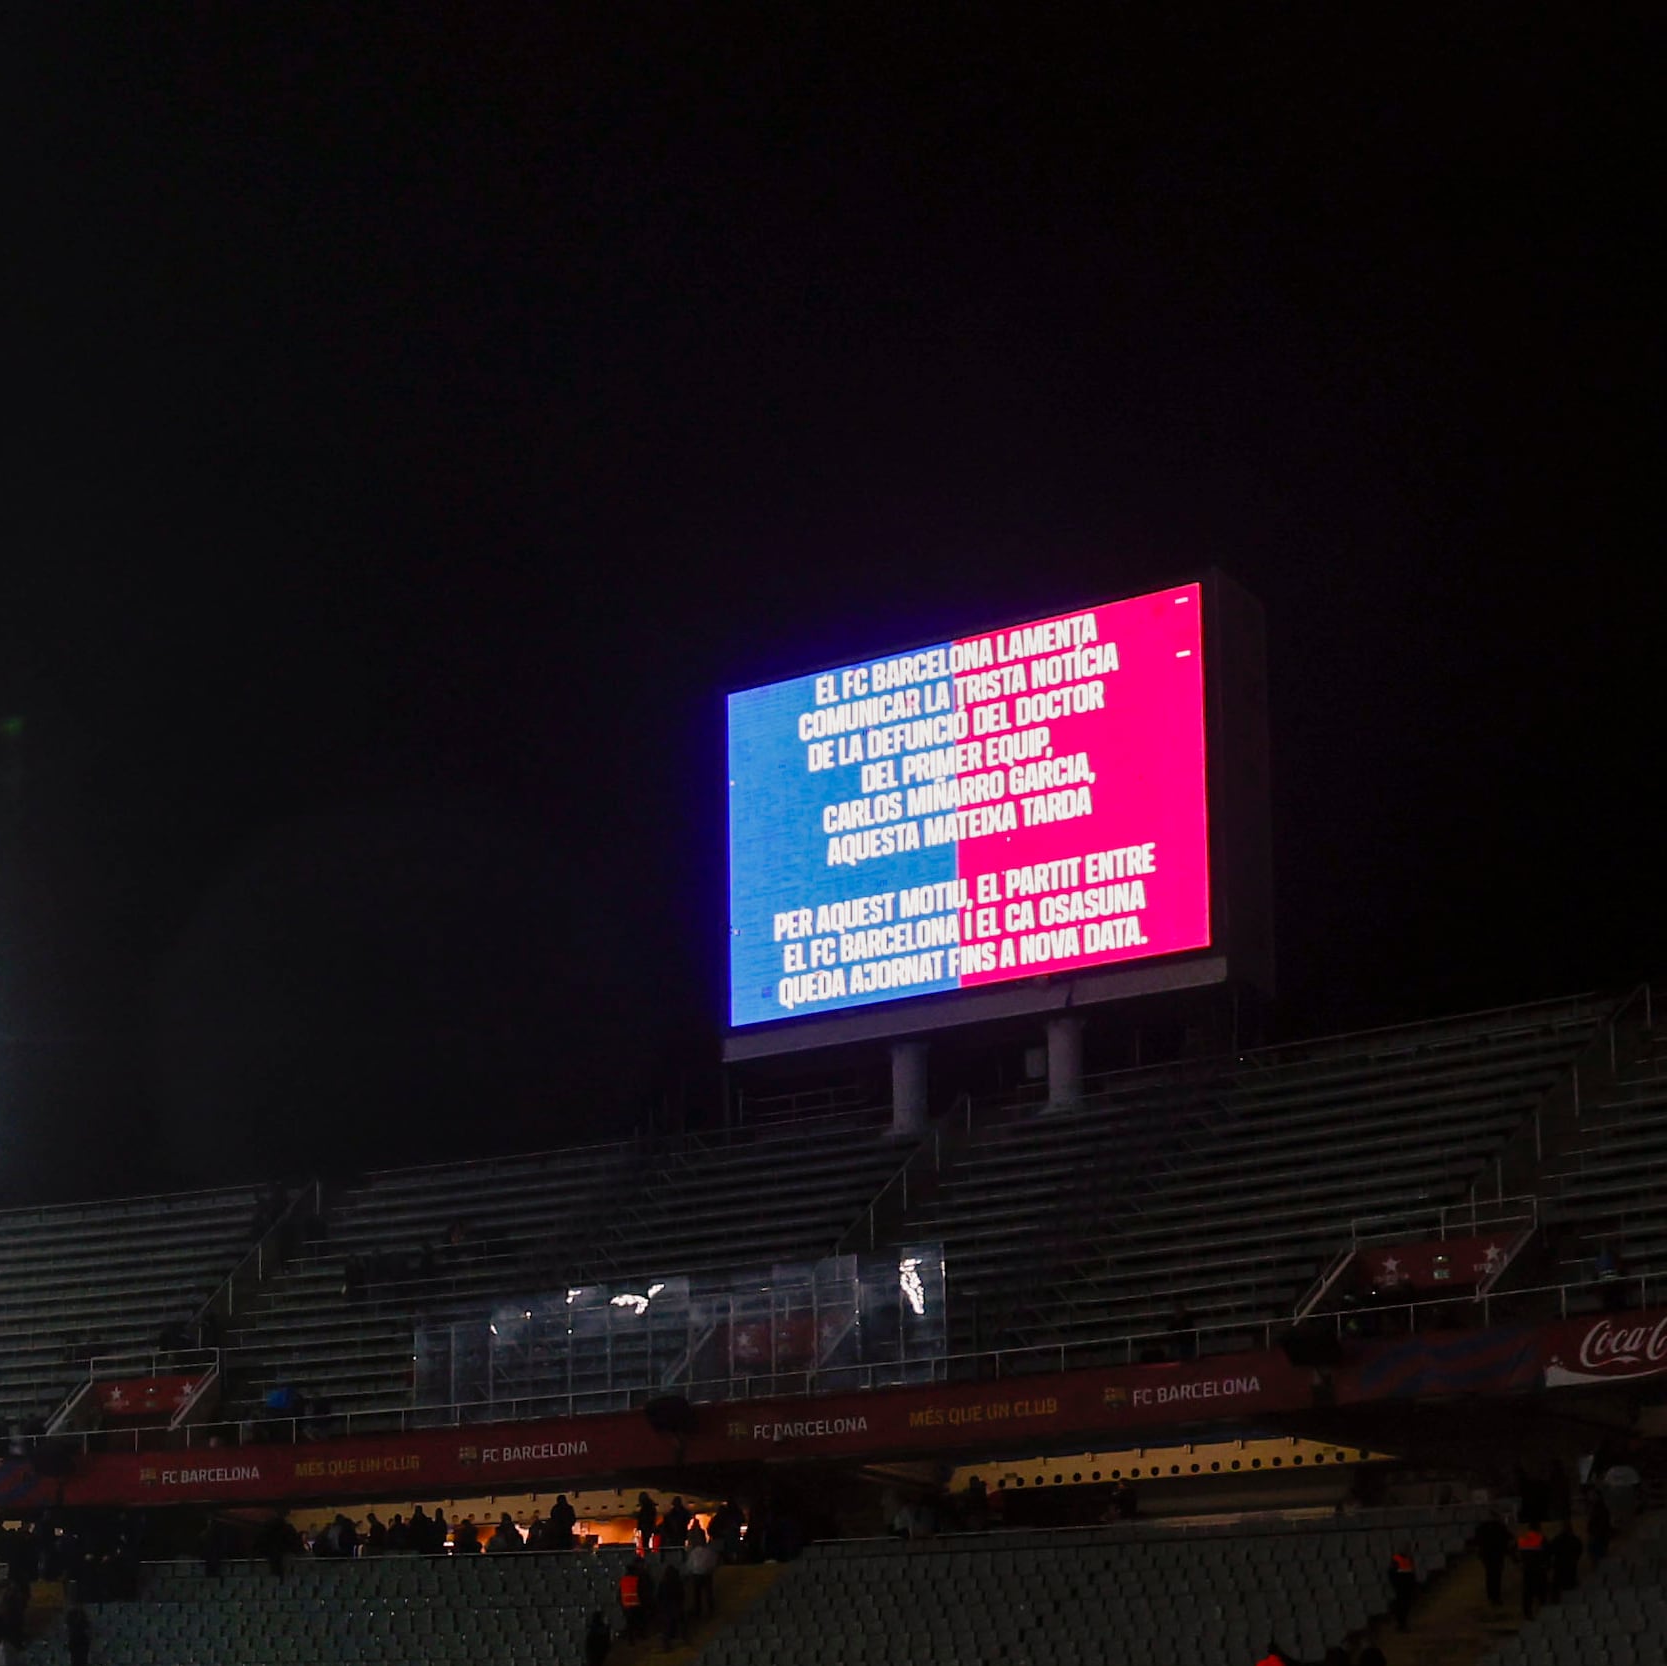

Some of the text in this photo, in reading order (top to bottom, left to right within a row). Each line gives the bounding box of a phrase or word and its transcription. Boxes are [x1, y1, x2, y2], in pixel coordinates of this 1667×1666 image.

[798, 639, 1118, 741] COMUNICAR LA TRISTA NOTÍCIA
[815, 613, 1097, 705] EL FC BARCELONA LAMENTA
[807, 680, 1104, 772] DE LA DEFUNCIÓ DEL DOCTOR
[861, 726, 1052, 793] DEL PRIMER EQUIP,
[822, 791, 902, 833] CARLOS
[827, 786, 1091, 866] AQUESTA MATEIXA TARDA
[773, 842, 1155, 941] PER AQUEST MOTIU, EL PARTIT ENTRE
[783, 942, 807, 973] EL
[809, 936, 836, 968] FC
[839, 913, 960, 963] BARCELONA
[976, 907, 1001, 937] EL
[1004, 900, 1035, 932] CA
[1039, 879, 1146, 926] OSASUNA
[778, 915, 1147, 1009] QUEDA AJORNAT FINS A NOVA DATA.
[948, 1403, 983, 1427] QUE
[1013, 1397, 1058, 1418] CLUB
[1132, 1375, 1261, 1407] FC BARCELONA
[482, 1440, 588, 1464] FC BARCELONA
[753, 1424, 772, 1440] FC
[161, 1465, 261, 1486] FC BARCELONA
